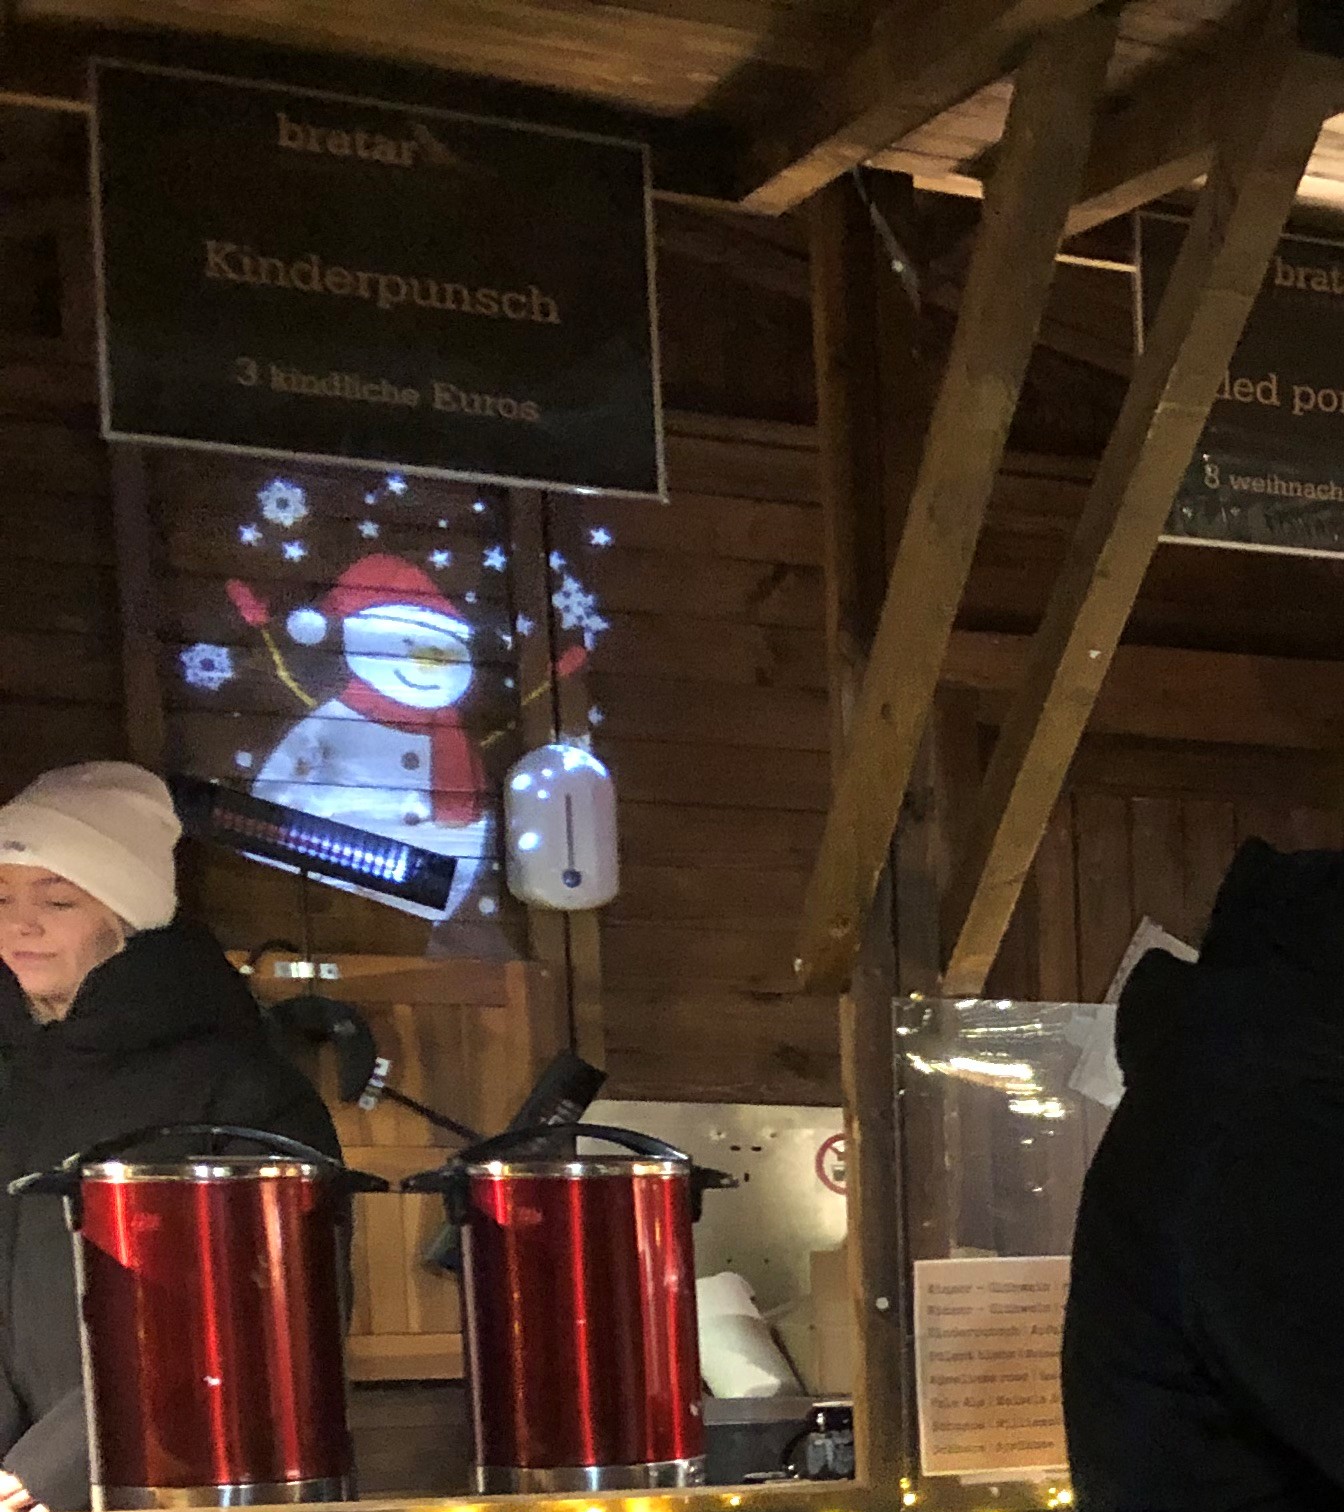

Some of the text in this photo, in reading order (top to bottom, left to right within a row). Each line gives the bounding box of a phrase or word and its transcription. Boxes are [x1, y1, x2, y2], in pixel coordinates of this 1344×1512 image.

[276, 112, 419, 168] bratar
[204, 240, 561, 325] Kinderpunsch
[236, 356, 541, 421] 3 kindliche Euros
[1203, 462, 1221, 489] 8
